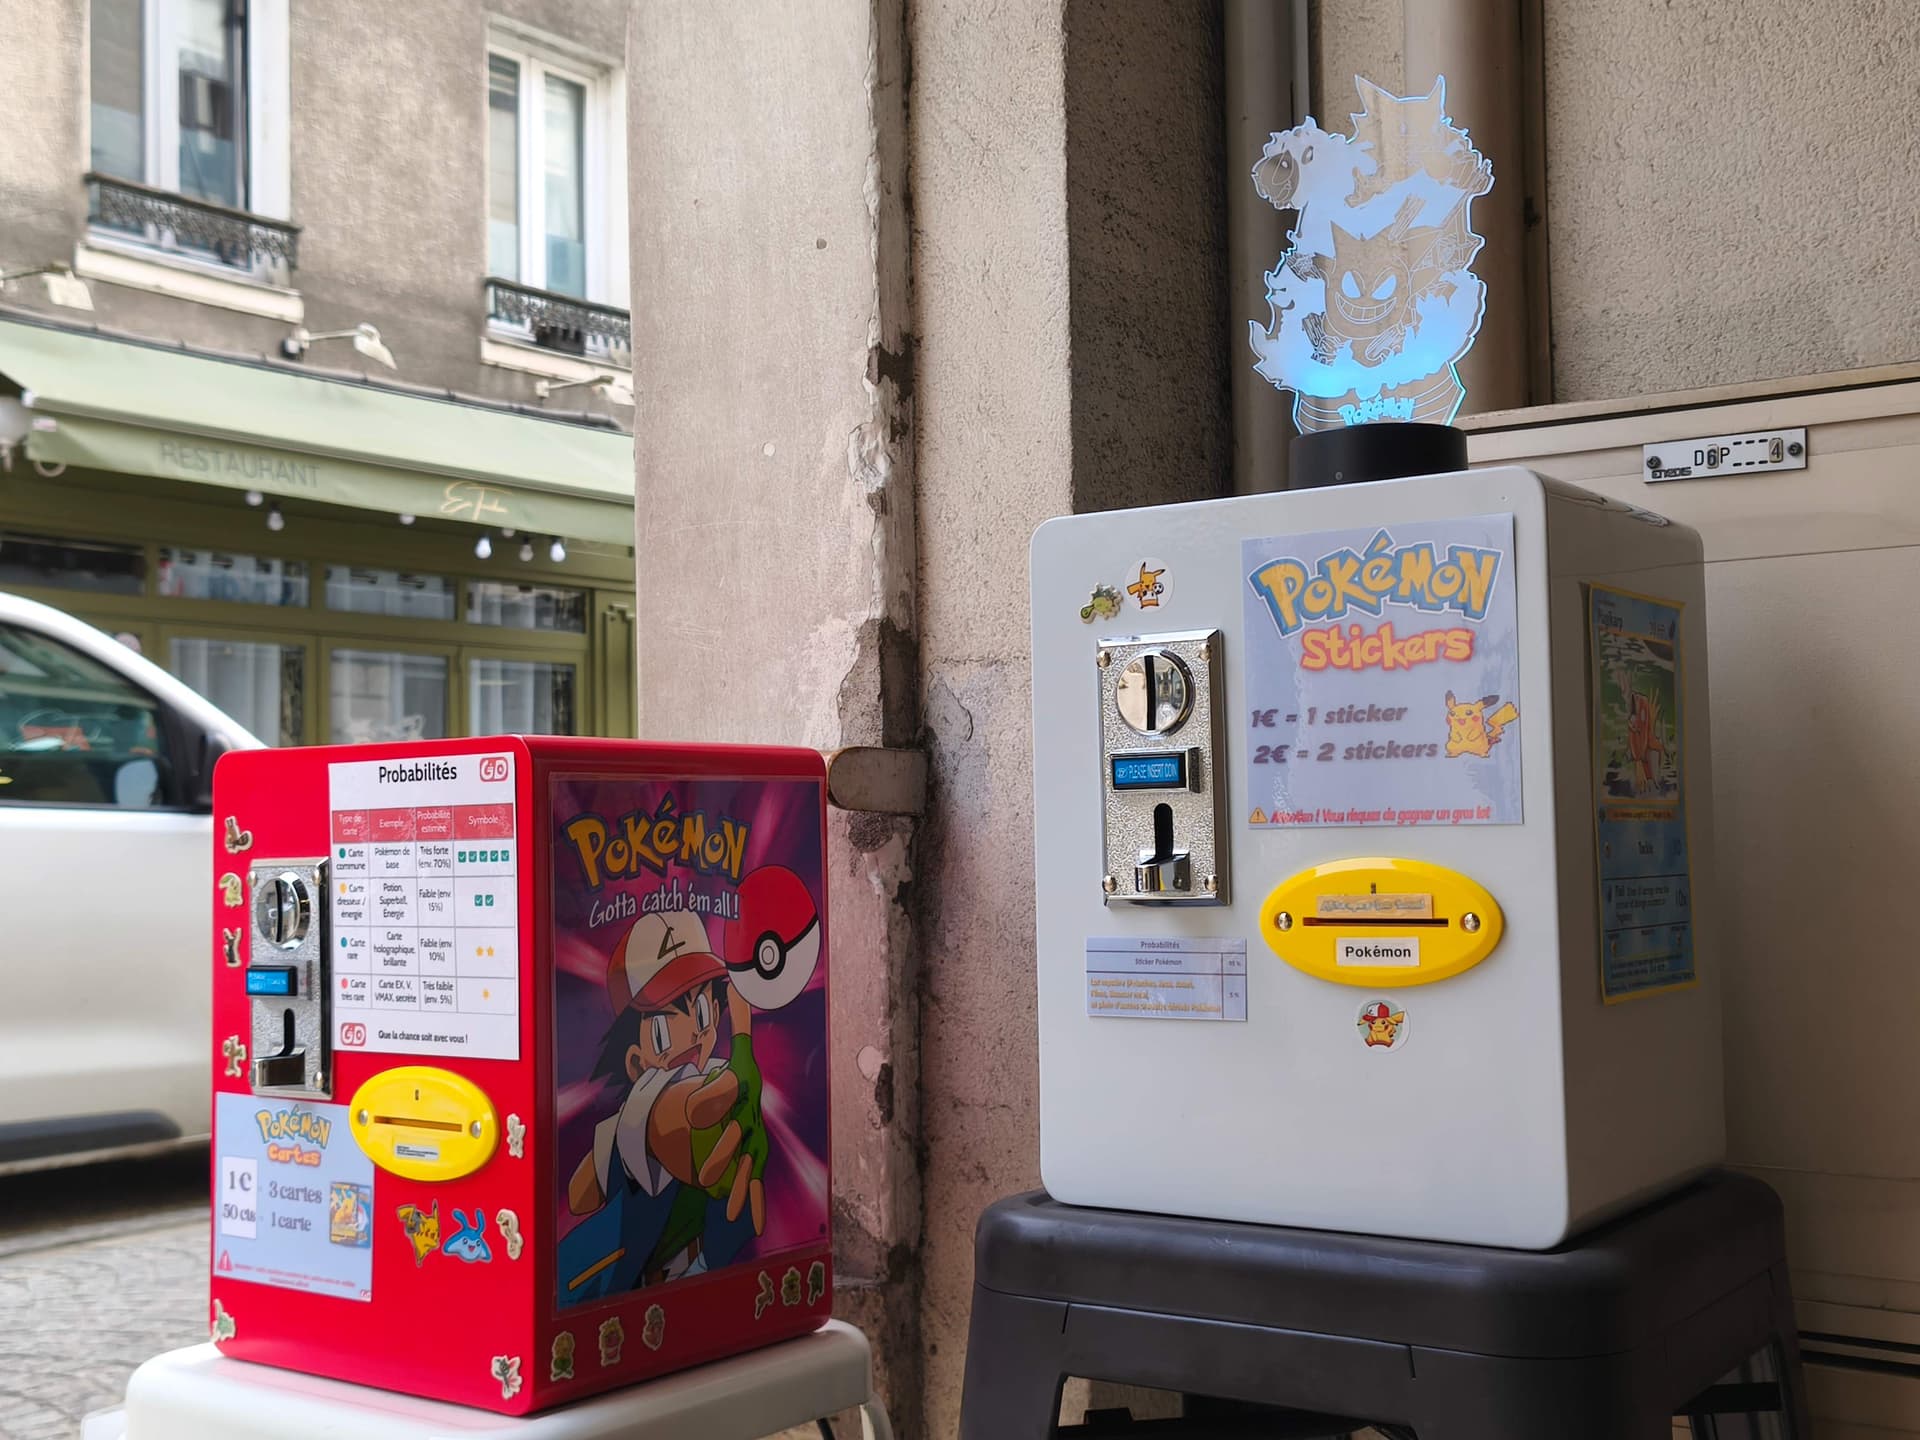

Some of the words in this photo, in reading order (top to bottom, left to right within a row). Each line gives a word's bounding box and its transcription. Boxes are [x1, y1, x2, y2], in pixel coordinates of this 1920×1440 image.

[158, 441, 321, 488] RESTAURANT
[1301, 621, 1475, 672] Stickers
[1252, 708, 1279, 728] 1€
[1325, 704, 1408, 725] sticker
[1253, 745, 1290, 764] 2€
[1317, 743, 1336, 761] 2
[1344, 741, 1438, 761] stickers
[379, 762, 457, 784] Probabilités
[1397, 809, 1434, 826] gagner
[1436, 809, 1450, 821] un
[348, 848, 364, 858] Carte
[433, 845, 449, 855] forte
[419, 889, 436, 898] Faible
[589, 893, 637, 929] Gotta
[642, 879, 683, 913] catch
[350, 937, 366, 948] Carte
[386, 931, 403, 941] Carte
[420, 938, 437, 948] Faible
[1345, 945, 1411, 958] Pokémon
[383, 957, 407, 967] brillante
[350, 979, 366, 989] Carte
[378, 979, 395, 989] Carte
[435, 980, 454, 991] faible
[378, 1029, 391, 1040] Que
[392, 1030, 398, 1040] la
[399, 1030, 420, 1041] chance
[421, 1032, 433, 1042] soit
[434, 1034, 448, 1043] avec
[449, 1035, 464, 1044] vous
[267, 1142, 321, 1166] Cartes
[269, 1180, 278, 1198] 3
[280, 1185, 322, 1204] cartes
[223, 1203, 239, 1220] 50
[278, 1215, 312, 1232] carte
